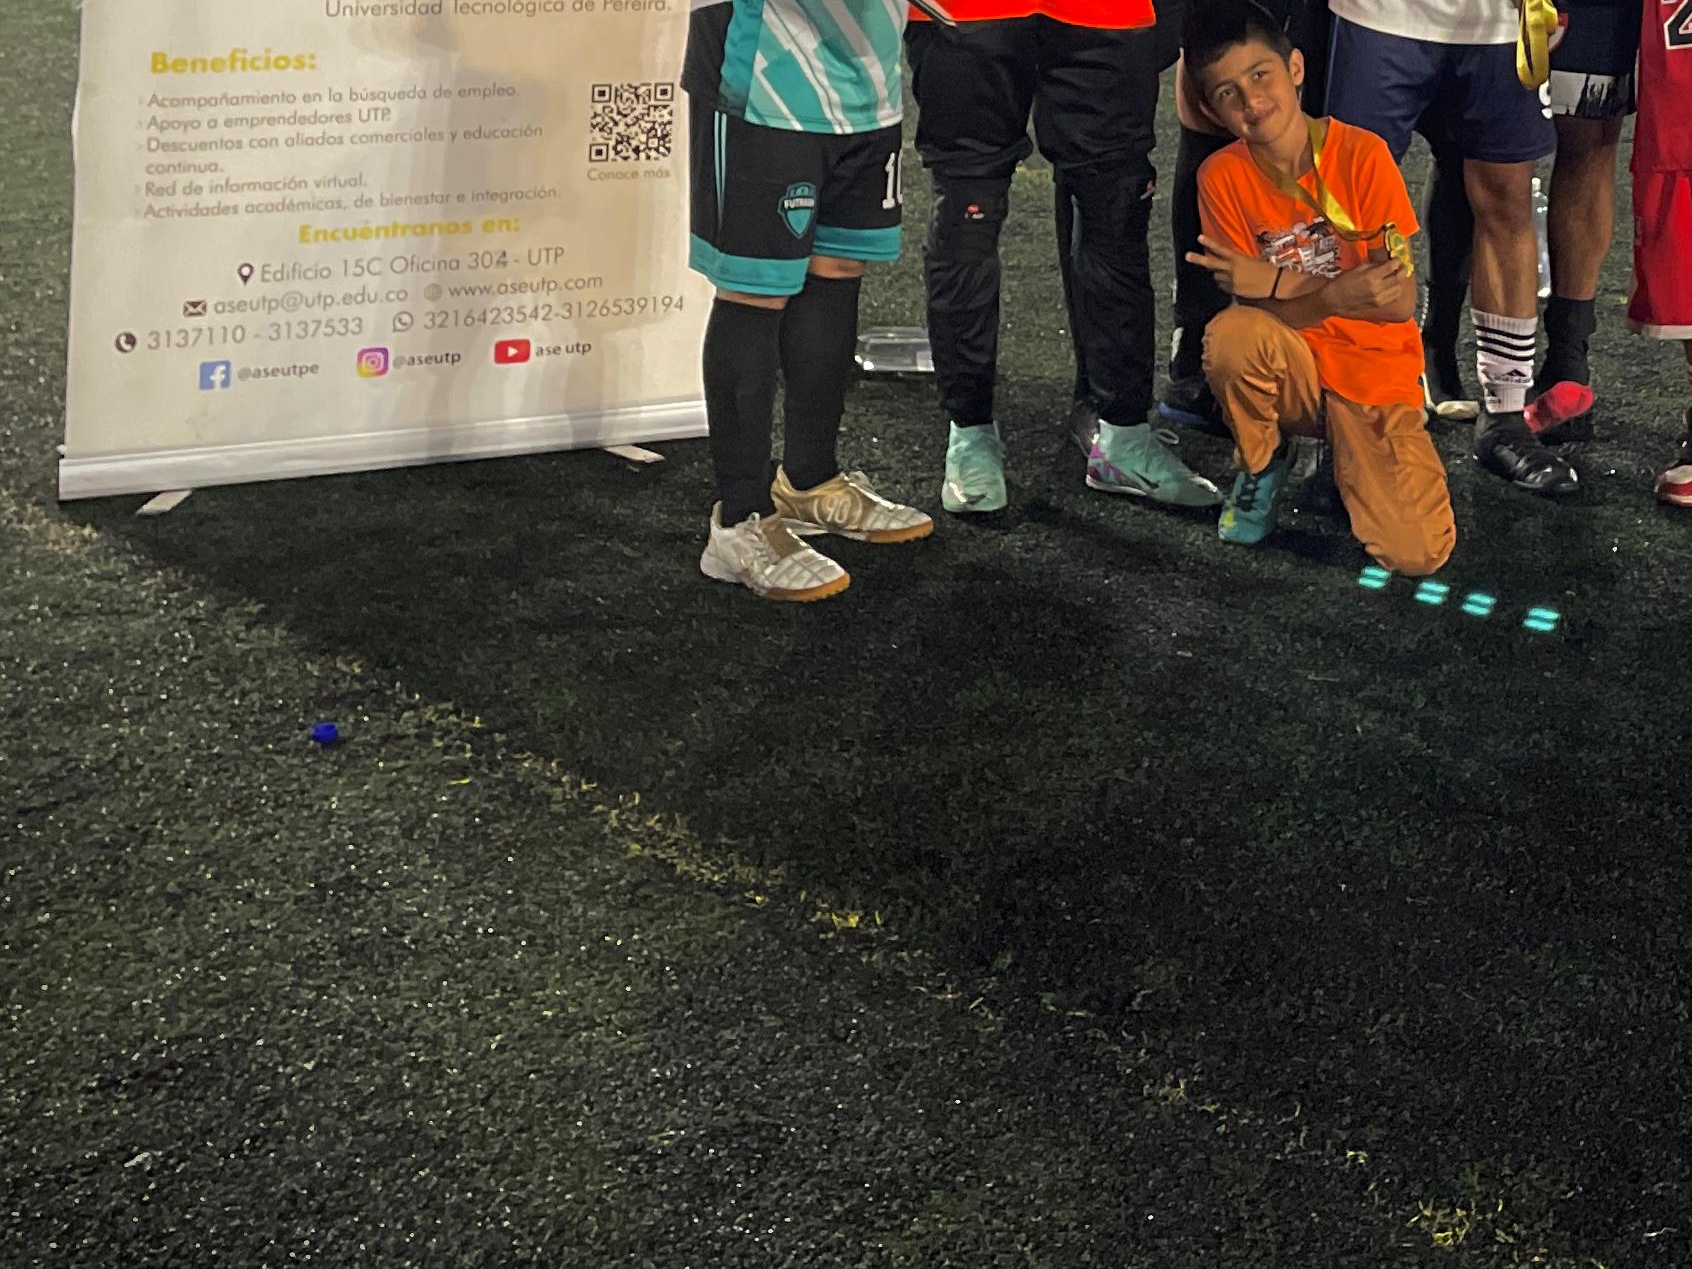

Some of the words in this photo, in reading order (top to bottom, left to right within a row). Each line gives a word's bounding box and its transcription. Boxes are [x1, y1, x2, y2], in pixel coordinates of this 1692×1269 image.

[150, 48, 317, 75] Beneficios:
[147, 90, 297, 111] Acompañamiento
[302, 92, 322, 103] en
[328, 87, 343, 102] la
[349, 84, 426, 104] búsqueda
[433, 84, 452, 99] de
[457, 82, 520, 102] empleo.
[147, 115, 201, 133] Apoyo
[207, 118, 218, 129] a
[224, 111, 352, 132] emprendedores
[147, 135, 243, 153] Descuentos
[249, 137, 279, 149] con
[284, 131, 344, 147] aliados
[349, 127, 444, 145] comerciales
[449, 131, 458, 144] y
[463, 124, 543, 141] educación
[145, 161, 224, 175] continua.
[587, 168, 638, 181] Conoce
[644, 168, 670, 179] más
[145, 180, 177, 197] Red
[182, 179, 204, 195] de
[209, 175, 308, 194] información
[314, 173, 368, 188] virtual.
[144, 201, 239, 219] Actividades
[245, 196, 348, 215] académicas,
[353, 194, 374, 208] de
[379, 192, 452, 208] bienestar
[456, 194, 466, 203] e
[471, 185, 562, 205] integración.
[299, 218, 472, 243] Encuéntranos
[481, 217, 520, 233] en:
[261, 262, 332, 283] Edificio
[342, 257, 383, 277] 15C
[390, 254, 460, 274] Oficina
[528, 246, 565, 266] UTP
[214, 285, 408, 316] aseutp@utp.edu.co
[449, 275, 603, 300] www.aseutp.com
[147, 324, 246, 350] 3137110
[268, 317, 362, 342] 3137533
[535, 345, 561, 357] ase
[566, 341, 592, 356] utp
